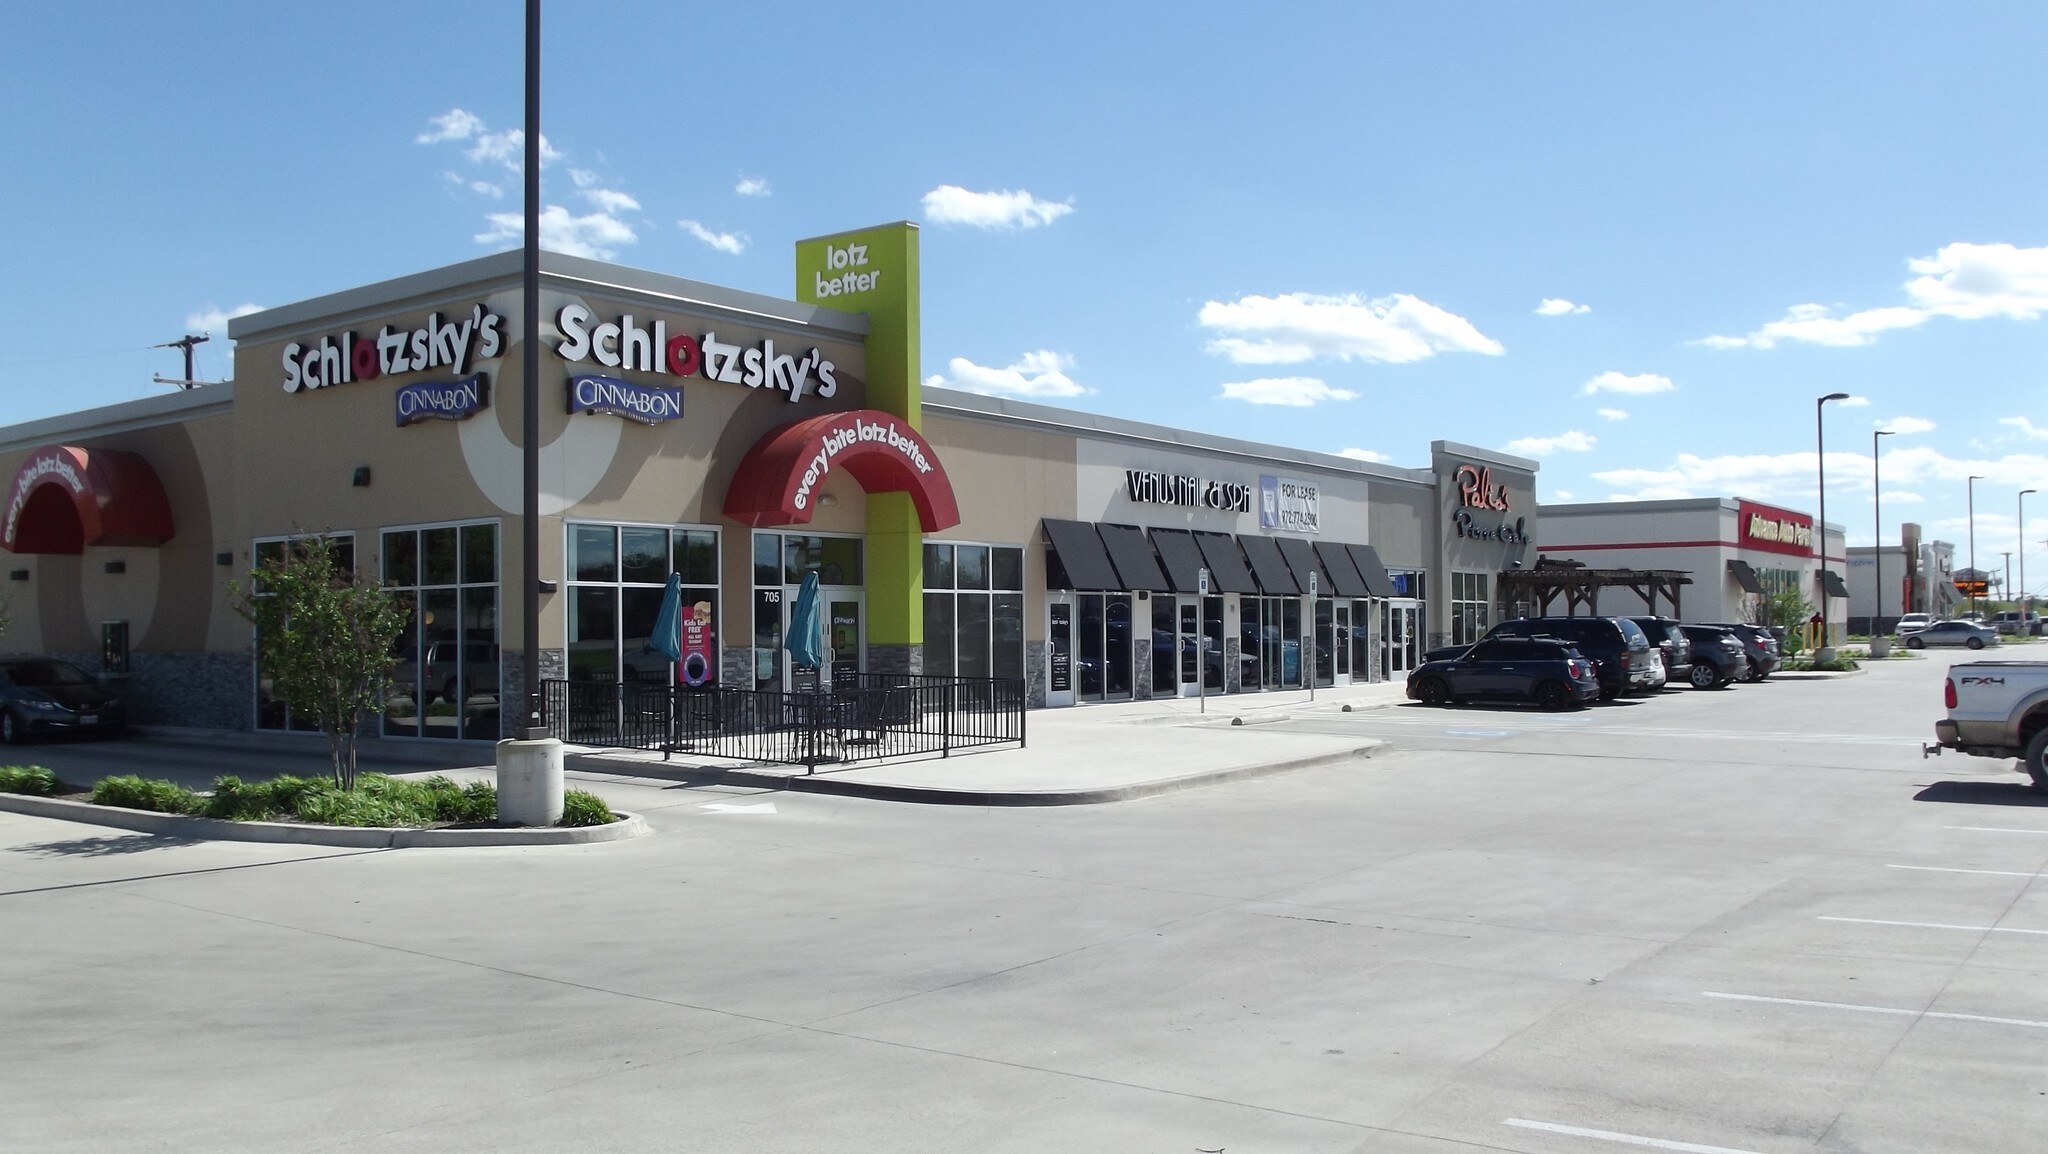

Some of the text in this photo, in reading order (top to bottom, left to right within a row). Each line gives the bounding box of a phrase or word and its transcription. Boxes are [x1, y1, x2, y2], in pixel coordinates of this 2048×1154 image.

[827, 243, 869, 271] lotz
[815, 270, 880, 298] better
[282, 303, 500, 393] Schlotzsky's
[555, 303, 838, 404] Schlotzsky's
[399, 380, 478, 415] CINNABON
[575, 379, 680, 415] CINNABON
[37, 456, 56, 475] lotz
[55, 452, 84, 494] better
[794, 418, 932, 510] every bite lotz better
[1127, 470, 1176, 504] VENUS
[1221, 482, 1252, 514] SPA
[1282, 484, 1296, 498] FOR
[1297, 486, 1316, 501] LEASE
[764, 591, 780, 603] 705
[1961, 677, 2005, 685] FX4
